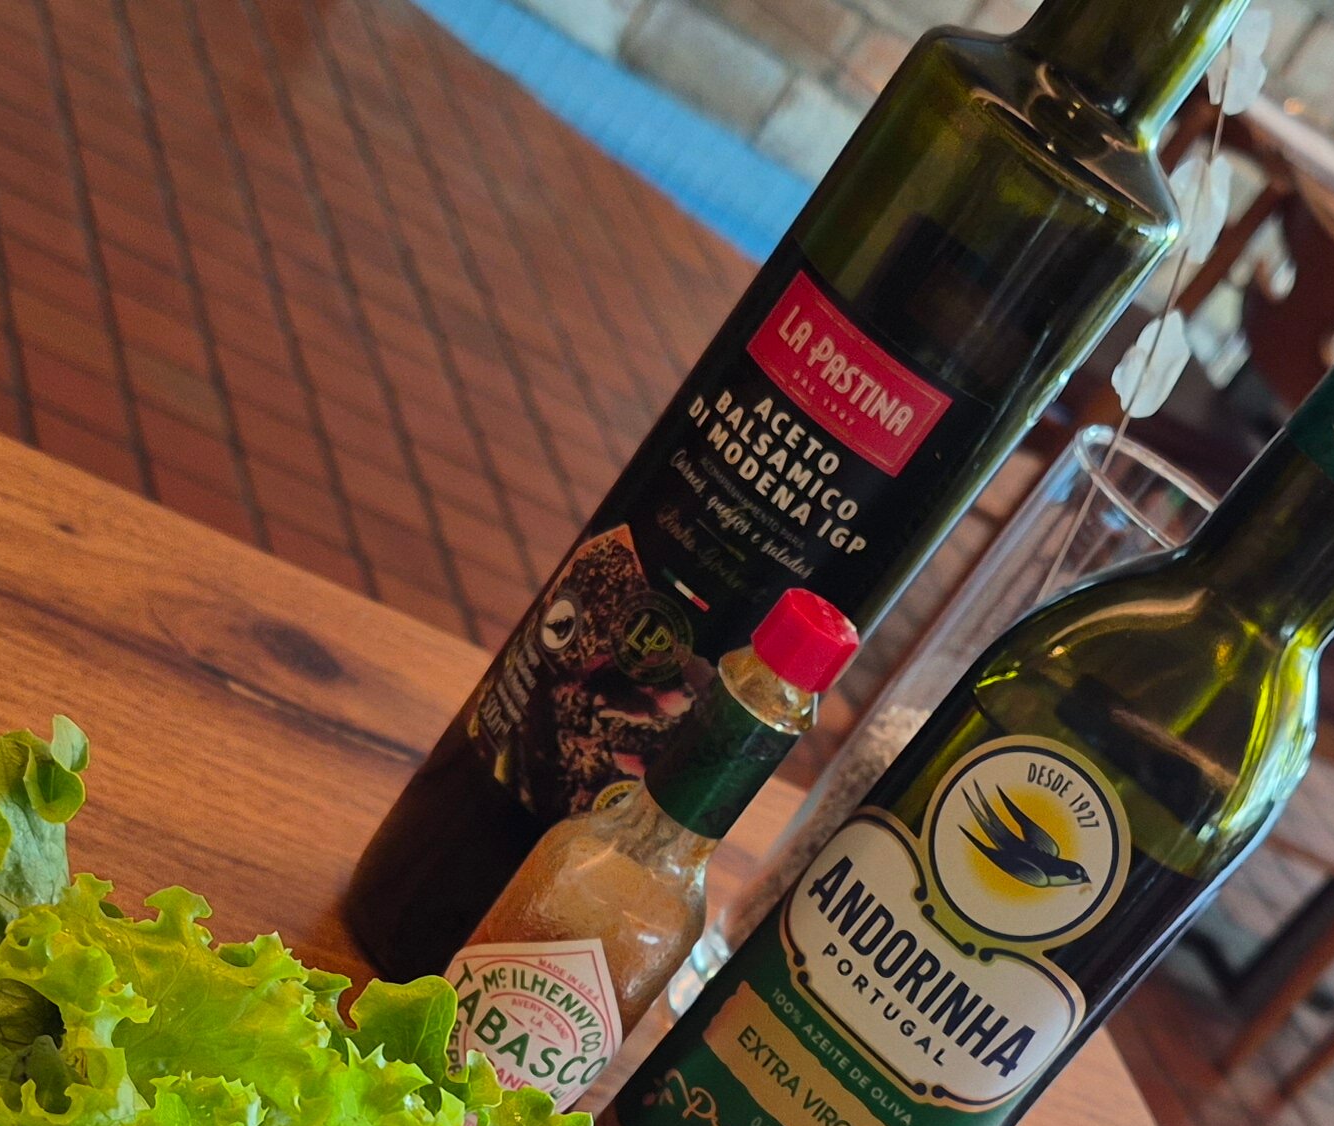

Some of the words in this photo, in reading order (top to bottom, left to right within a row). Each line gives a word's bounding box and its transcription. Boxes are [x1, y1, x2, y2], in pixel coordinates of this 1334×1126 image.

[777, 304, 813, 354] LA
[808, 336, 915, 437] PASTINA
[687, 396, 710, 429] DI
[707, 419, 809, 528] MODENA
[817, 517, 868, 555] IGP
[714, 389, 859, 522] BALSAMICO
[753, 397, 840, 477] ACETO
[750, 533, 762, 544] e
[760, 540, 815, 580] saladas
[779, 527, 806, 549] PARA
[1027, 762, 1073, 798] DESDE
[1068, 792, 1100, 829] 1927
[539, 958, 567, 978] MADE
[567, 974, 578, 984] IN
[807, 855, 1036, 1078] ANDORINHA
[821, 942, 947, 1067] PORTUGAL
[455, 962, 608, 1085] TABASCO
[512, 998, 542, 1013] AVERY
[544, 1010, 569, 1040] ISLAND
[736, 1025, 801, 1098] EXTRA
[772, 988, 804, 1026] 100%
[802, 1022, 848, 1069] AZEITE
[849, 1065, 869, 1090] DE
[870, 1086, 913, 1126] OLIVA
